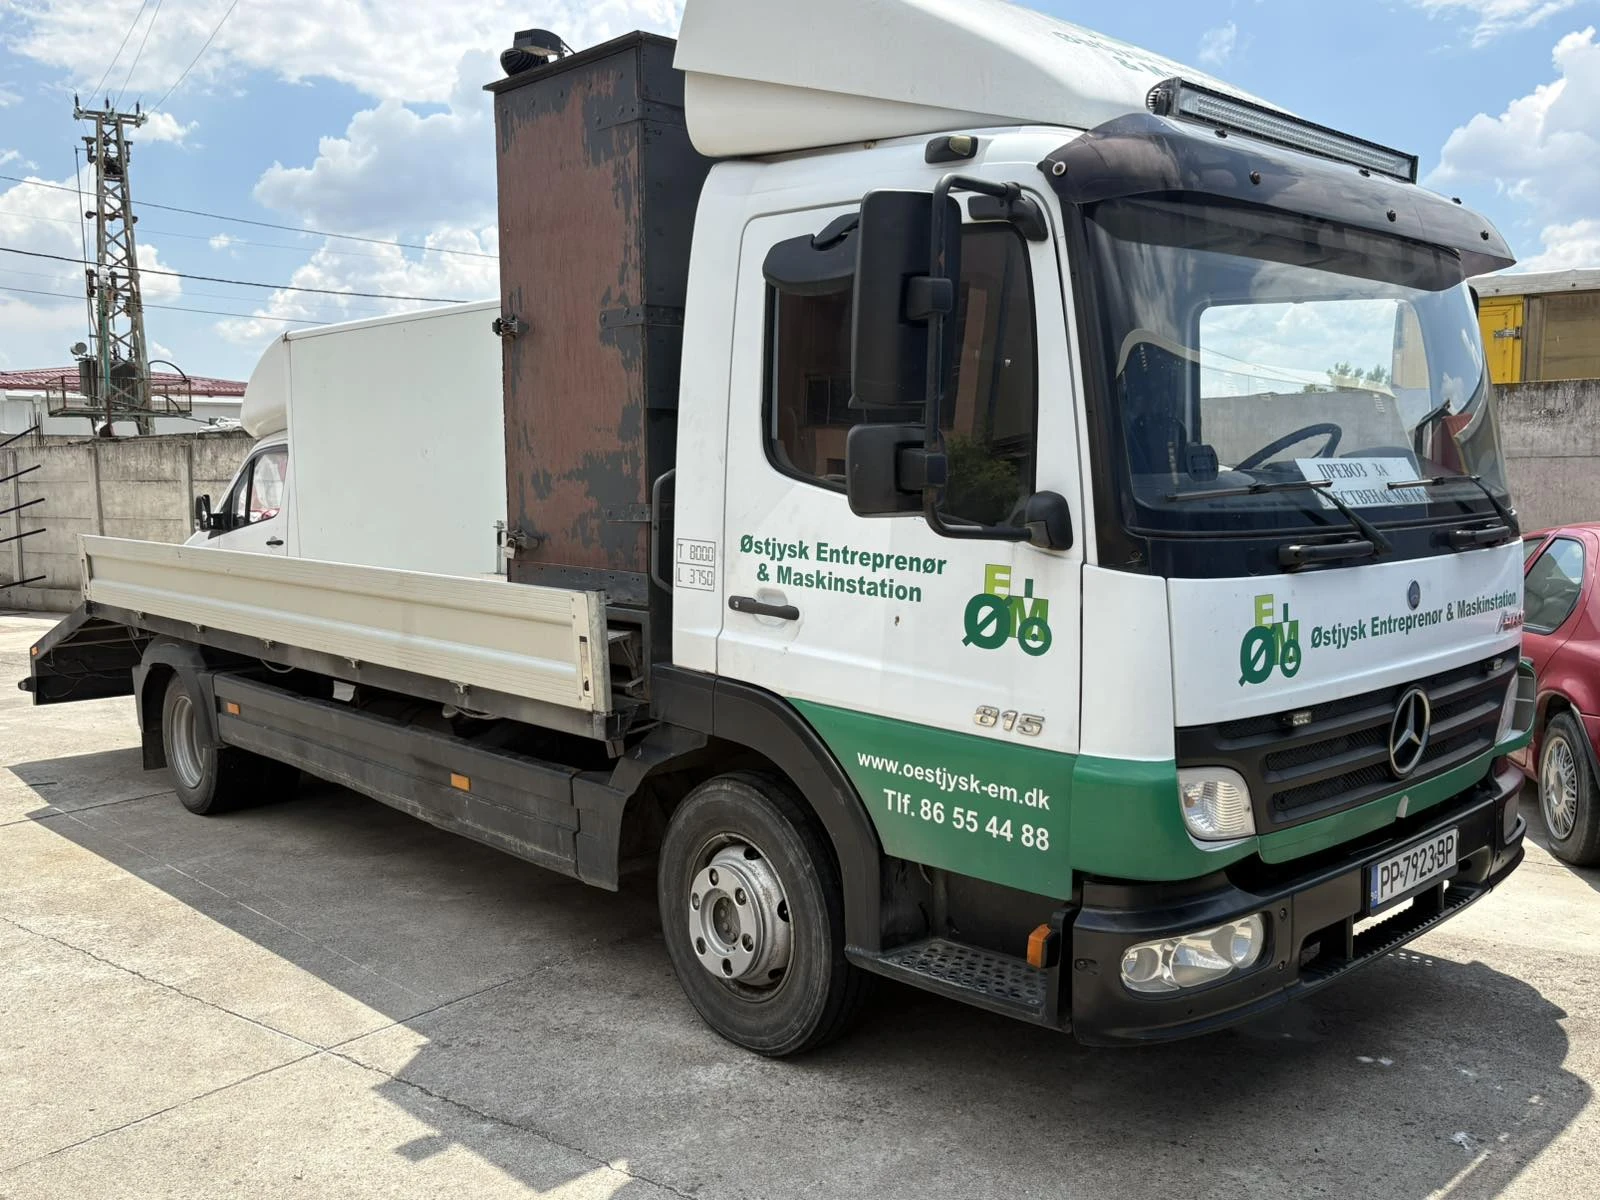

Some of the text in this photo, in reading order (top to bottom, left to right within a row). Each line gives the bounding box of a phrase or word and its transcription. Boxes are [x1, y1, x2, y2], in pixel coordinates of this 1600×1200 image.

[1317, 463, 1367, 478] ПРЕВОЗ
[690, 544, 714, 562] 8000
[740, 534, 947, 575] Østjysk Entreprenør
[689, 568, 713, 586] 3750
[757, 563, 922, 602] & Maskinstation
[1311, 589, 1517, 649] Østjysk Entreprenør & Maskinstation
[973, 705, 1046, 737] 815
[857, 752, 1050, 810] www.oestjysk-em.dk
[883, 788, 1050, 851] Tlf. 86 55 44 88
